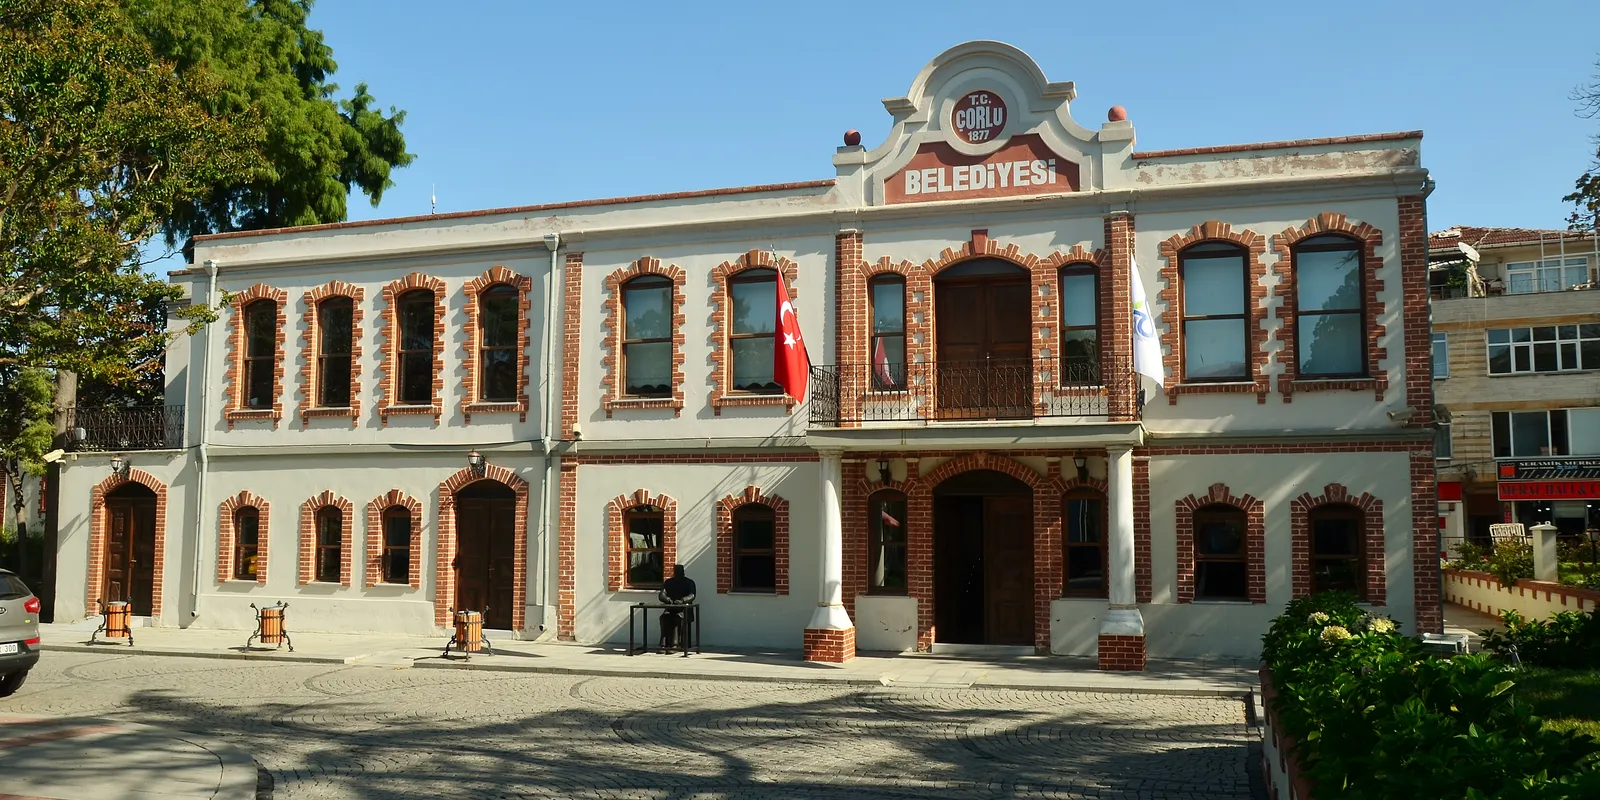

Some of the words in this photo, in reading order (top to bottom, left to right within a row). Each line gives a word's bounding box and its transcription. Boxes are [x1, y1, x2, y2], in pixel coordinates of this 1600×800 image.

[968, 93, 992, 105] T.C.
[955, 106, 1003, 132] ÇORLU
[967, 129, 990, 142] 1877
